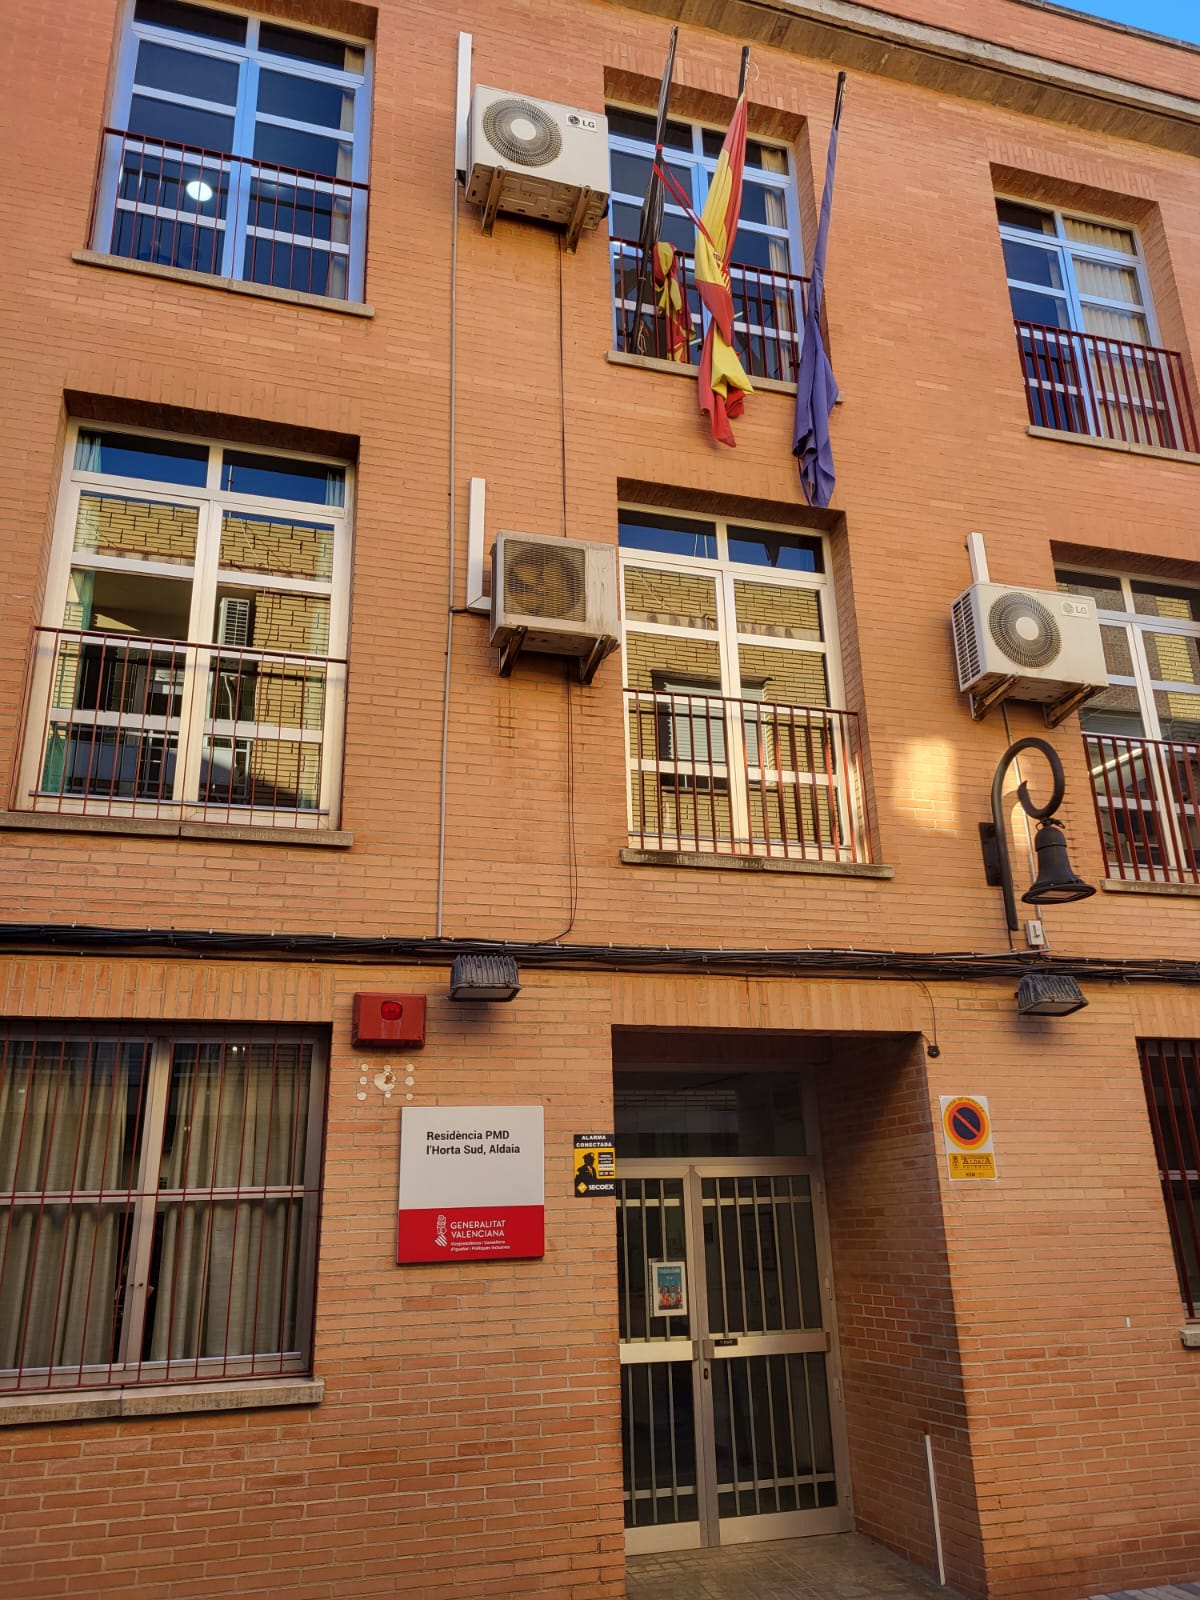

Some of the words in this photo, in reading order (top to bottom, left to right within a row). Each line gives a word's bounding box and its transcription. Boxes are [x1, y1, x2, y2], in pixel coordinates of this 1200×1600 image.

[582, 119, 595, 129] LG
[1075, 605, 1088, 615] LG
[426, 1130, 483, 1141] Residència
[485, 1130, 510, 1140] PMD
[426, 1145, 461, 1155] l'Horta
[463, 1144, 487, 1156] Sud,
[488, 1143, 521, 1154] Aldaia
[450, 1219, 507, 1230] GENERALITAT
[451, 1229, 505, 1239] VALENCIANA
